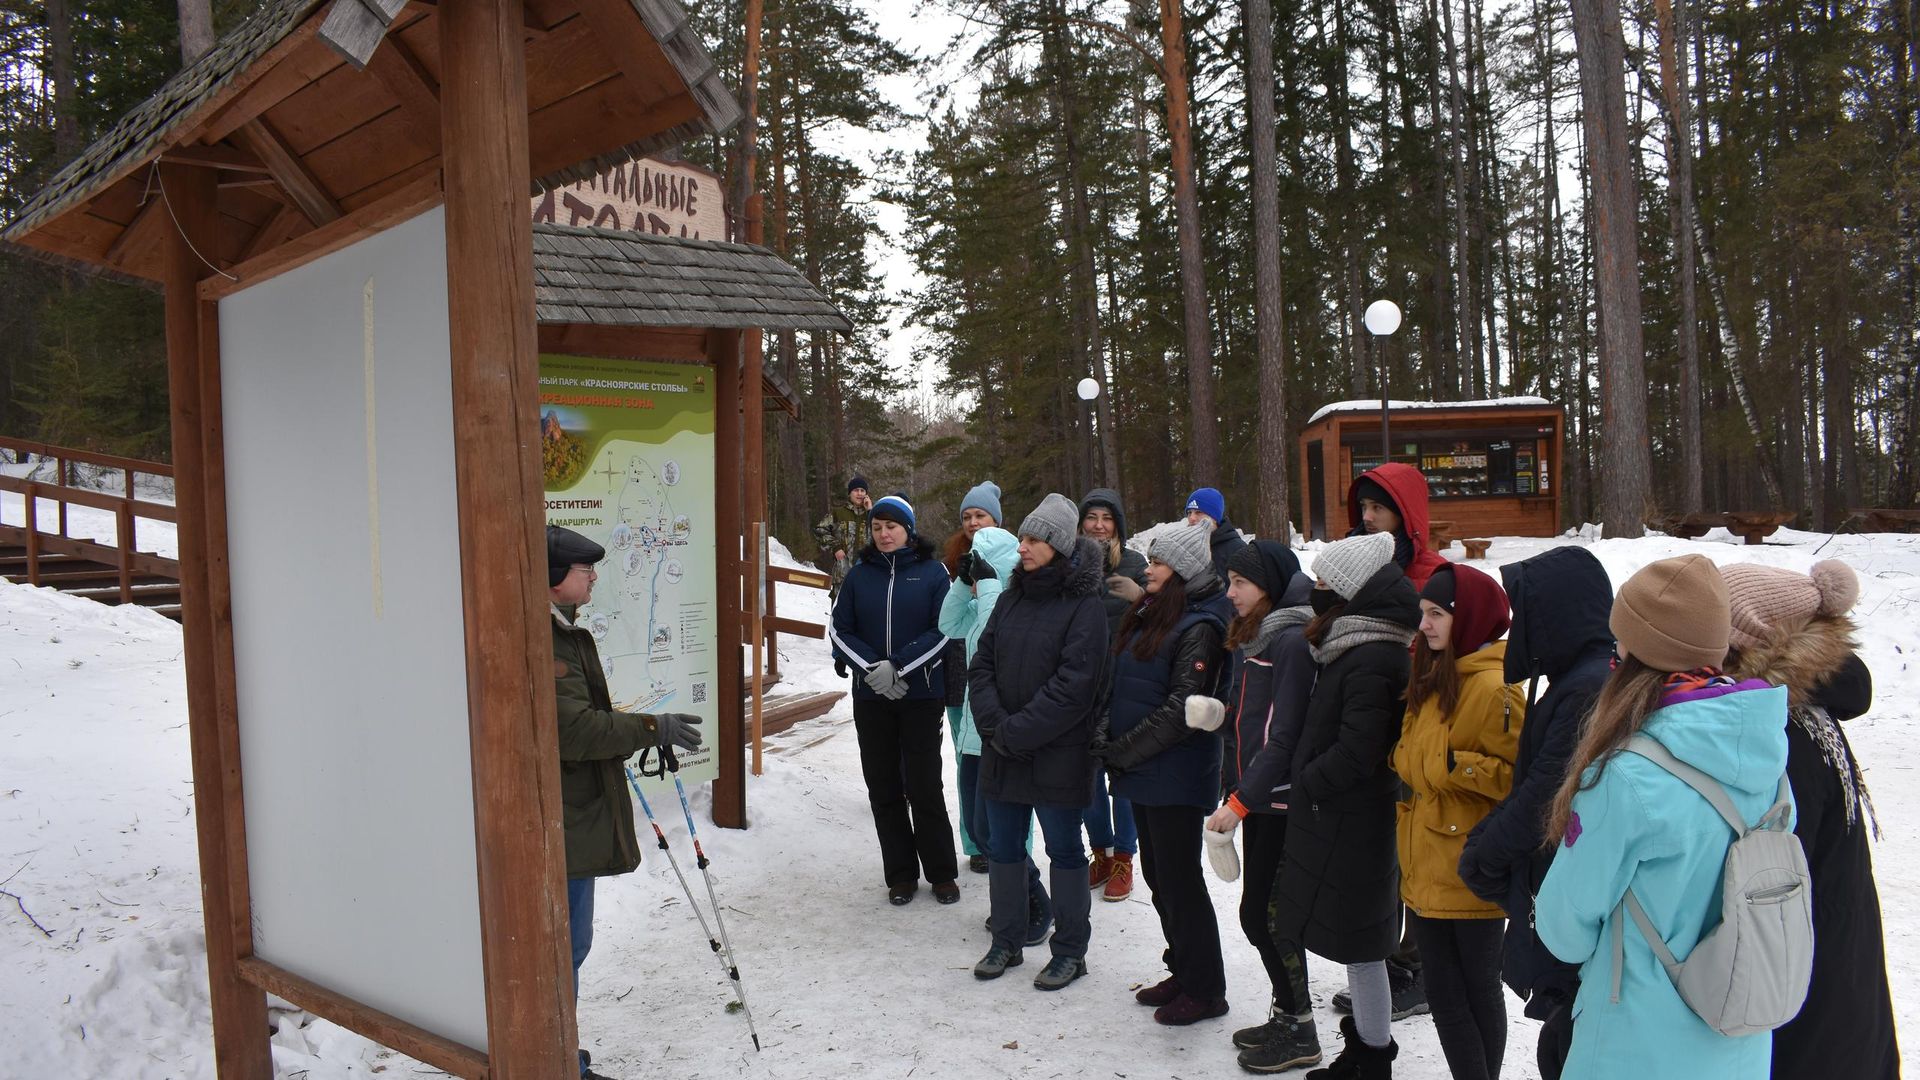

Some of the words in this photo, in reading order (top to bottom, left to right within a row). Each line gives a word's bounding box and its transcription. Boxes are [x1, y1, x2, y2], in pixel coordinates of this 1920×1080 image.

[559, 378, 578, 387] ПАРК
[580, 379, 650, 391] «КРАСНОЯРСКИЕ
[651, 383, 688, 393] СТОЛБЫ»
[556, 518, 603, 527] МАРШРУТА:
[680, 757, 710, 769] ИВОТНЫМИ
